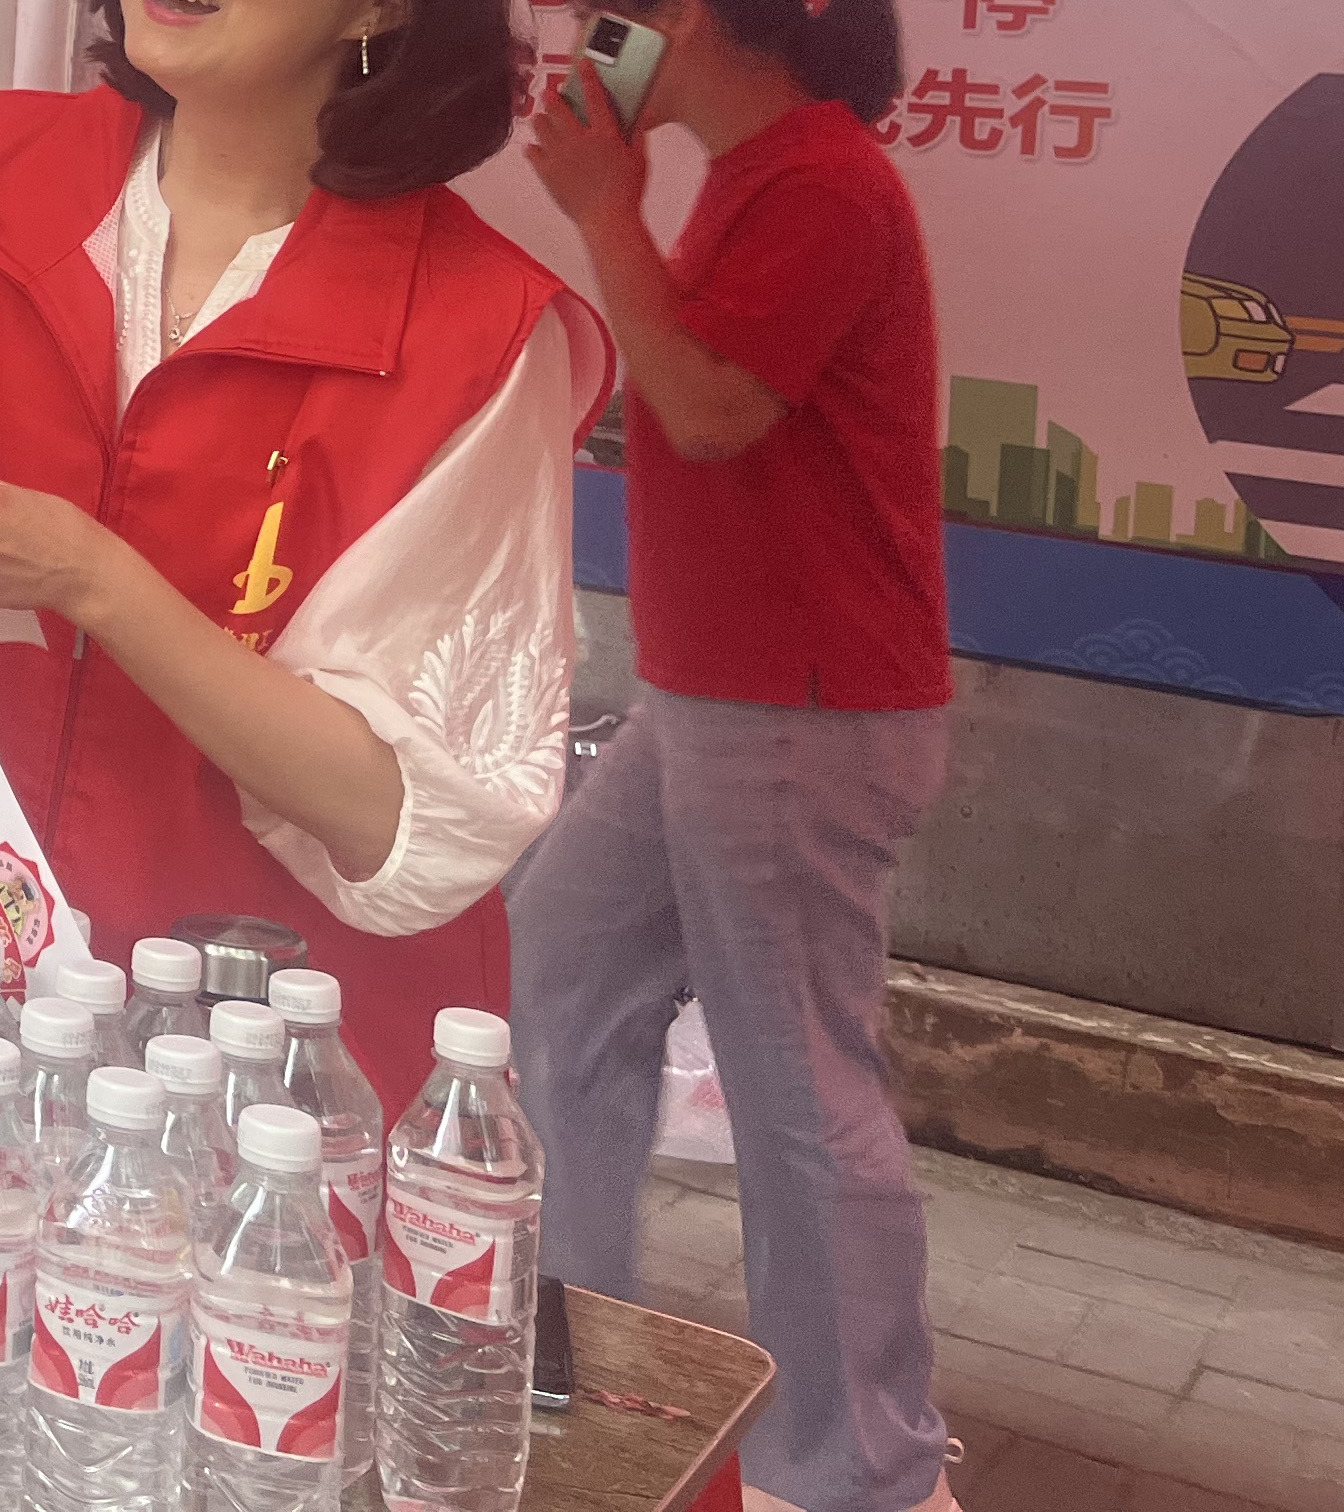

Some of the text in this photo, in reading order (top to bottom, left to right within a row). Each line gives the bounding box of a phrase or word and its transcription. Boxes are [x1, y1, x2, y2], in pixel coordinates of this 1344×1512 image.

[872, 67, 1112, 160] 先行
[45, 1294, 140, 1335] 娃哈哈
[226, 1338, 329, 1378] Wahaha
